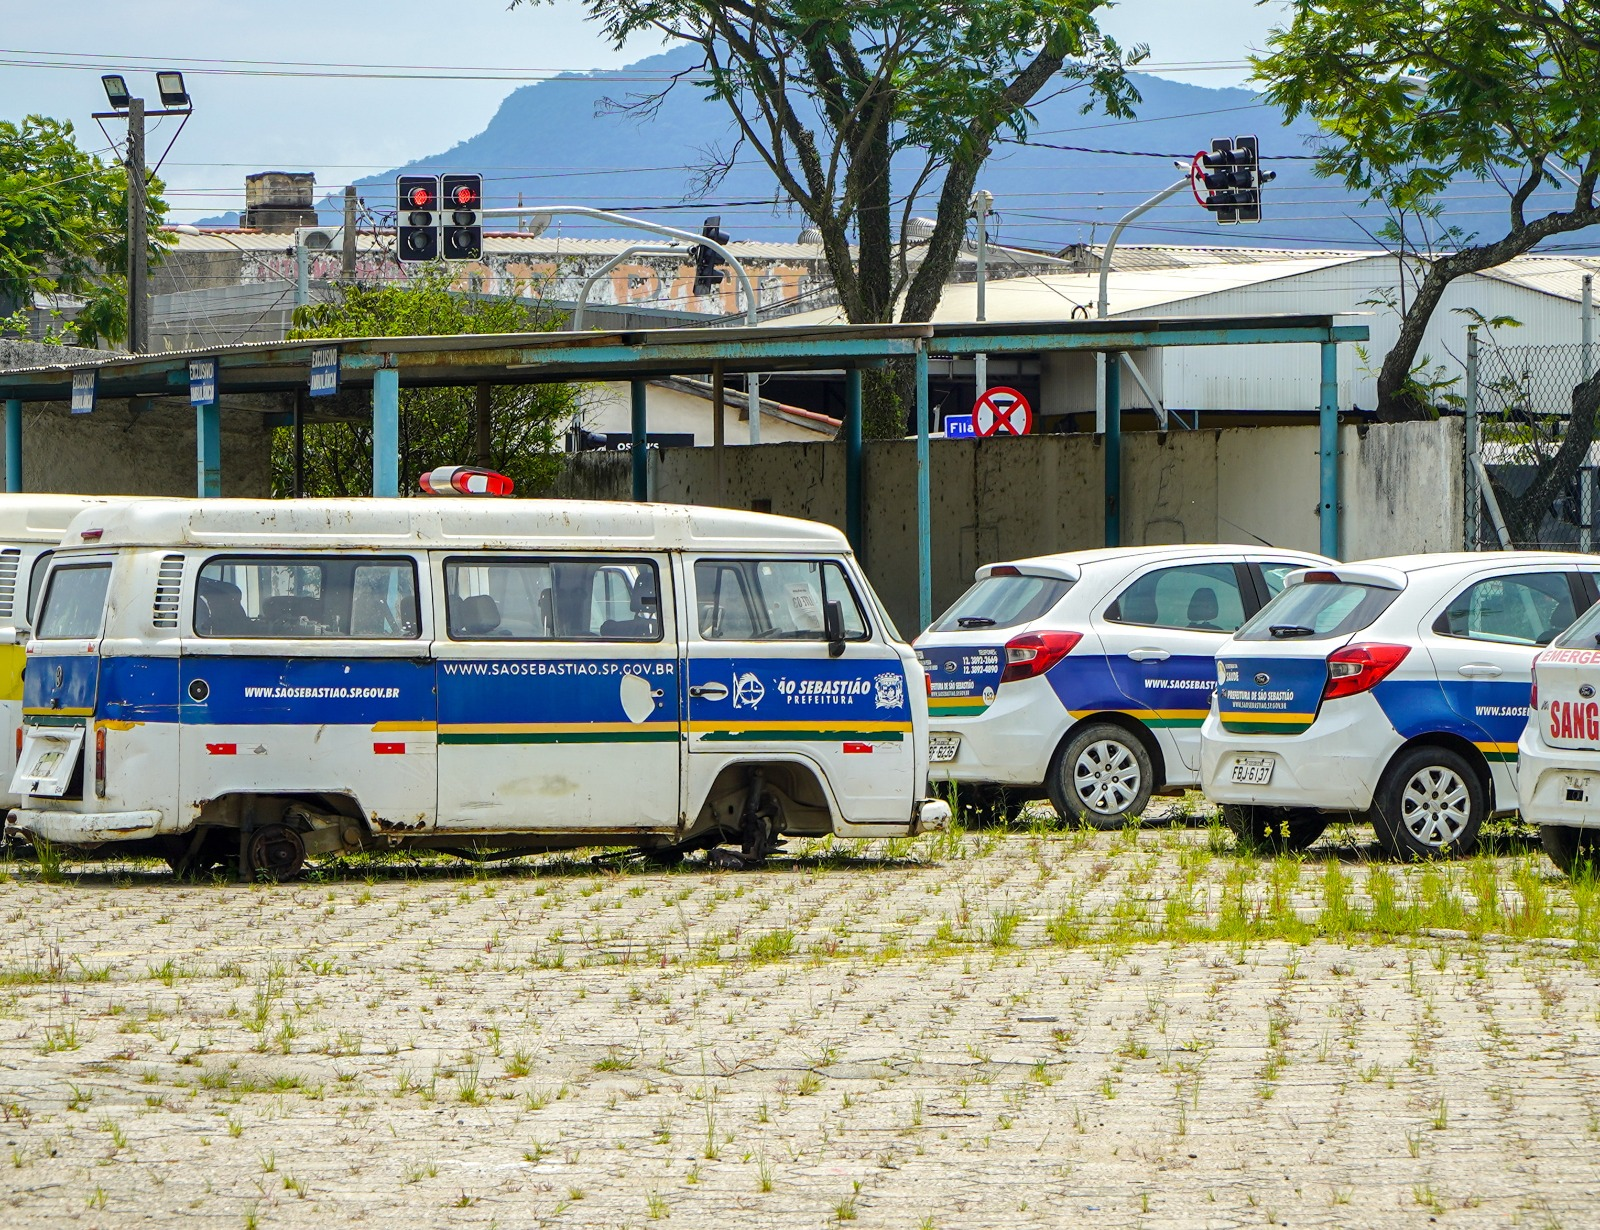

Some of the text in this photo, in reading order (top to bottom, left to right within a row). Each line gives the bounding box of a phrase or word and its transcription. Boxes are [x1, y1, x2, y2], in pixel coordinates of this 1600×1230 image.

[311, 348, 337, 368] EXCLUSIVO
[1541, 650, 1600, 665] EMERGE
[443, 663, 674, 676] WWW.SAOSEBASTIAO.SP.GOV.BR
[244, 687, 400, 699] WWW.SAOSEBASTIAO.SP.GOV.BR
[798, 677, 871, 695] SEBASTIÃO
[787, 695, 853, 705] PREFEITURA
[1550, 700, 1600, 741] SANG
